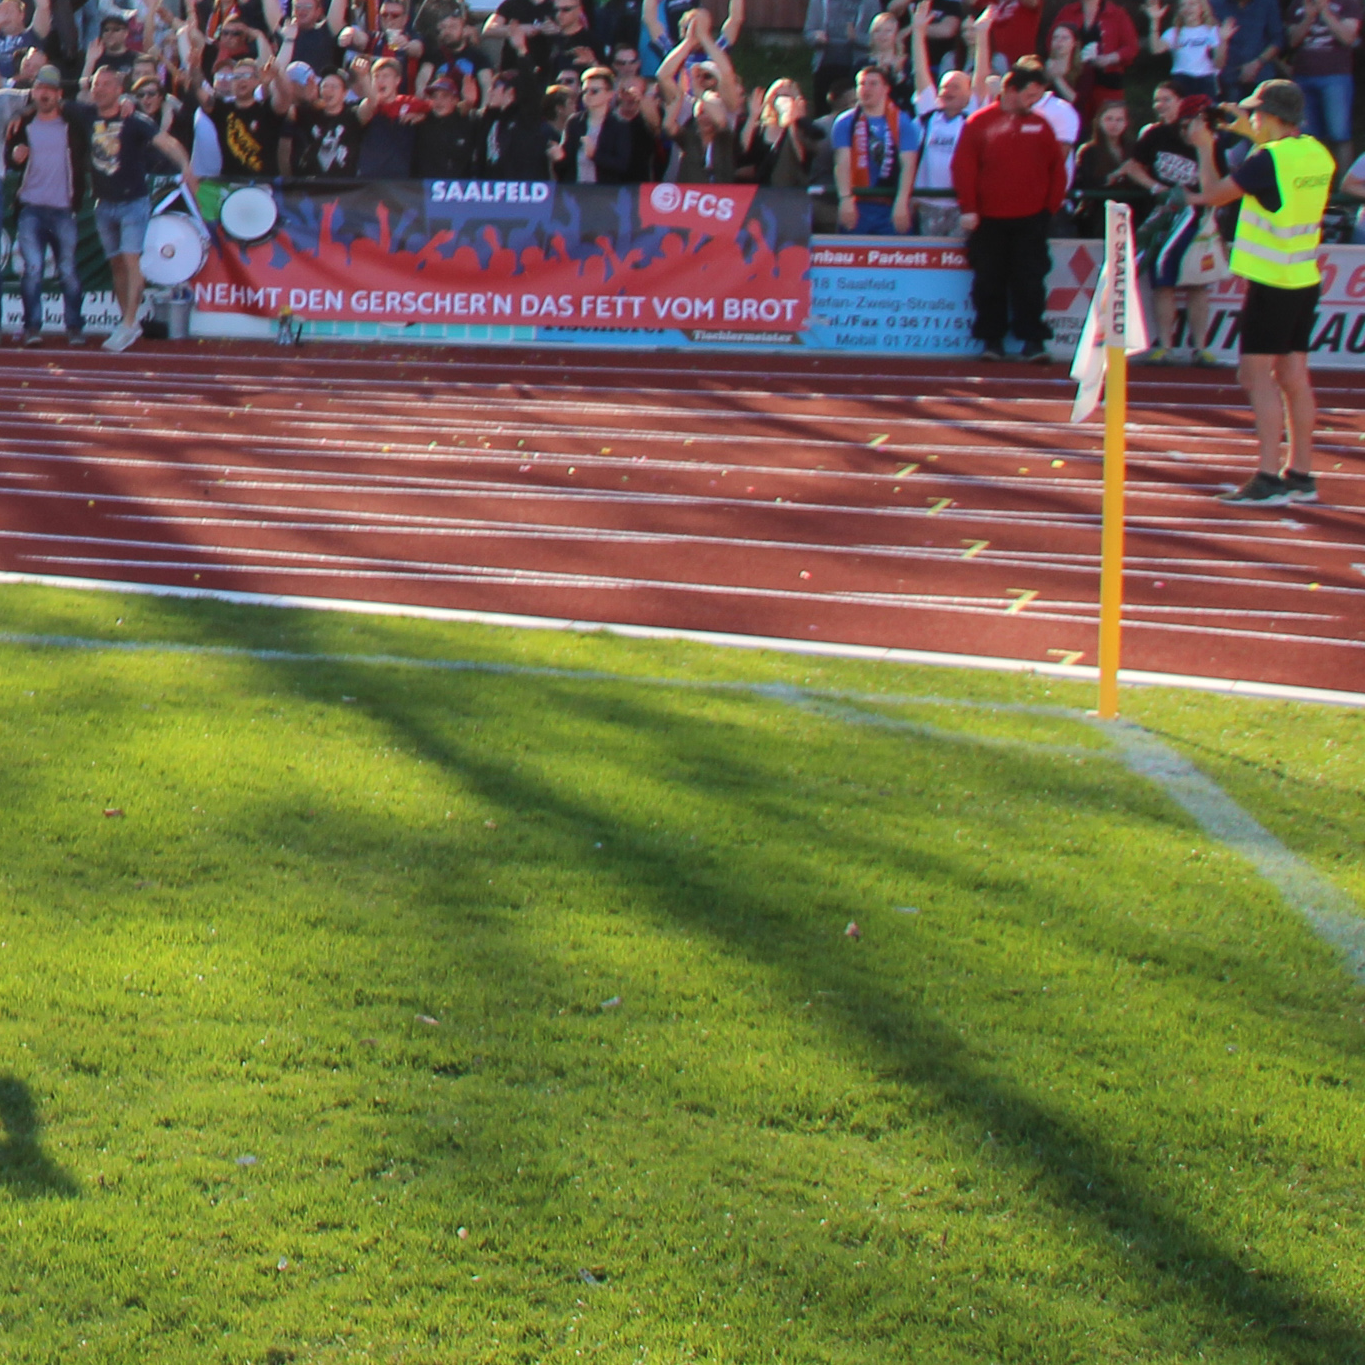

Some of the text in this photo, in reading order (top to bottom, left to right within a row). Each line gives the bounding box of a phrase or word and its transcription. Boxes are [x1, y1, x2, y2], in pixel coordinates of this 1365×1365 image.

[431, 180, 549, 204] SAALFELD
[681, 189, 735, 221] FCS
[867, 249, 928, 267] Parkett
[194, 282, 800, 322] NEHMT DEN GERSCHER'N DAS FETT VOM BROT
